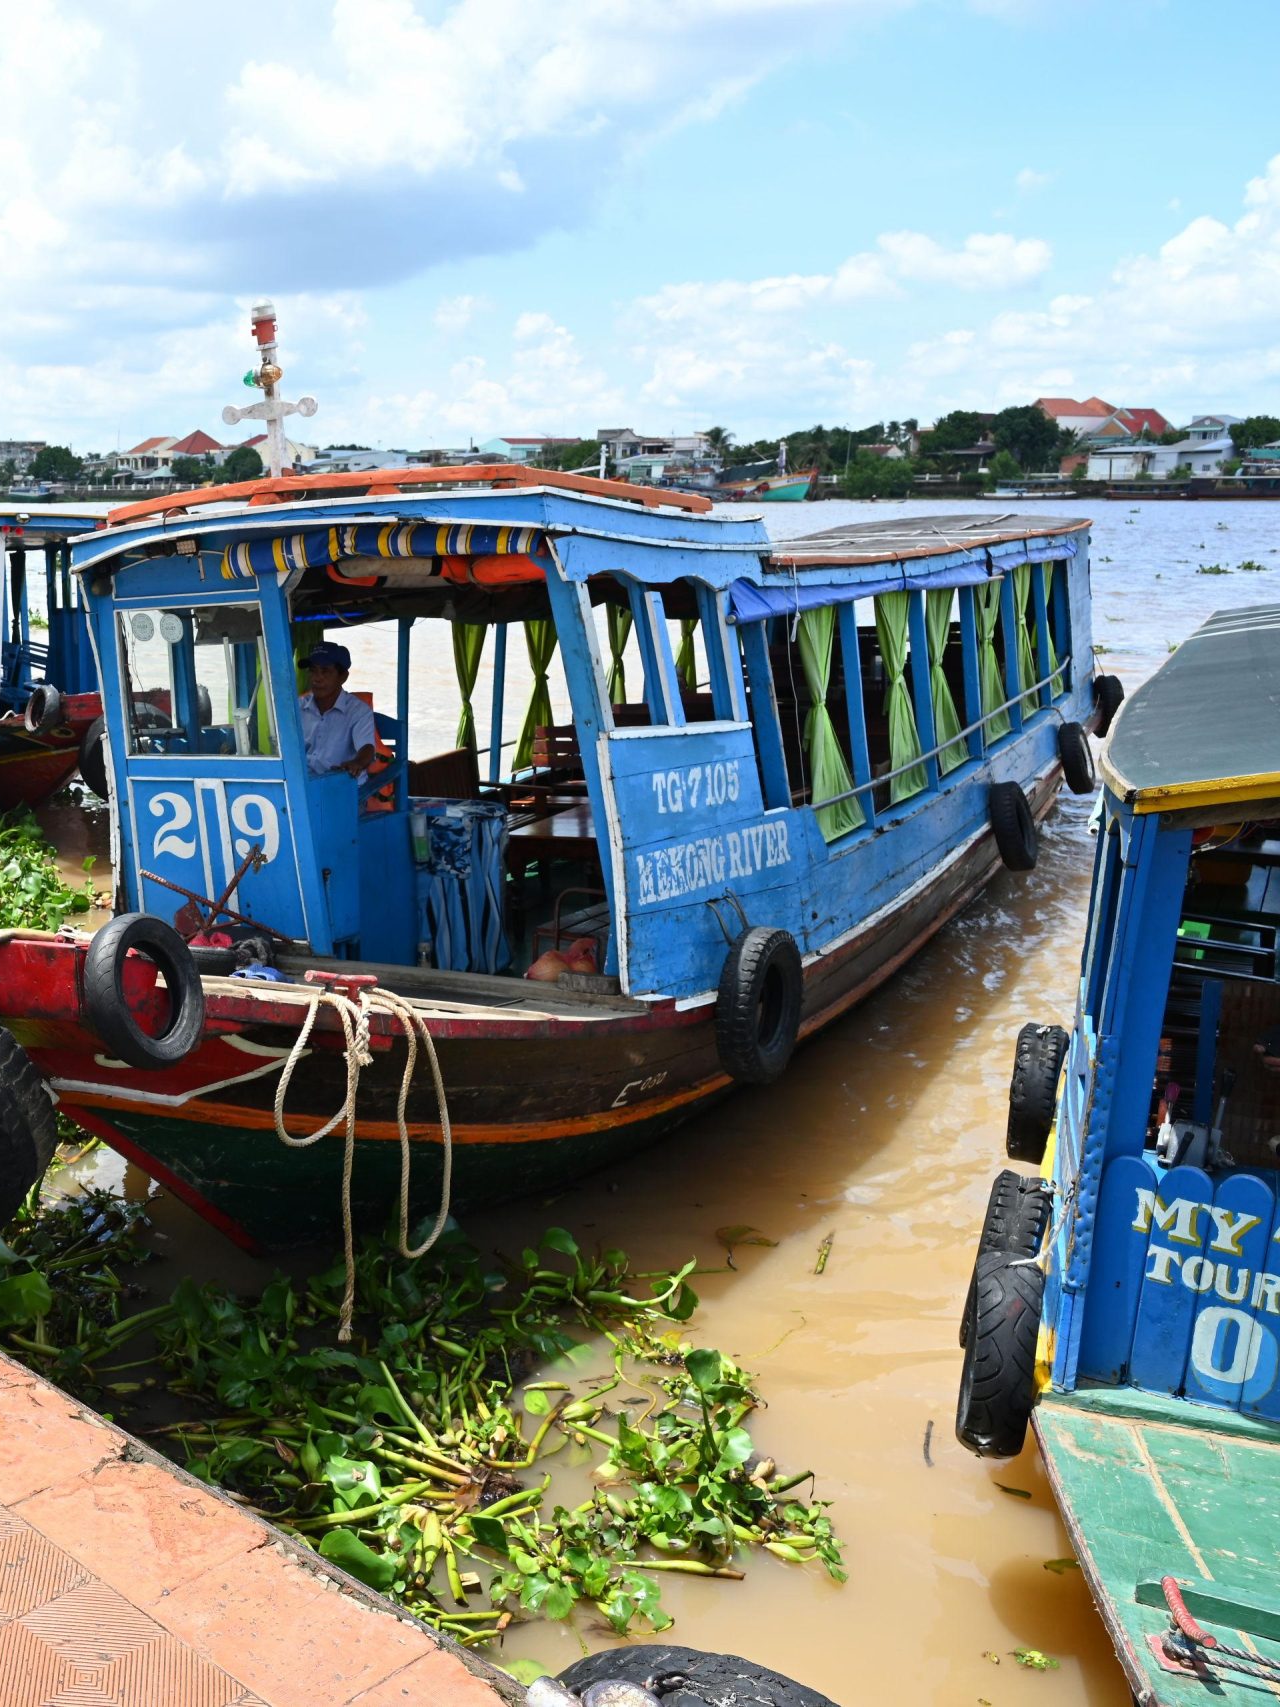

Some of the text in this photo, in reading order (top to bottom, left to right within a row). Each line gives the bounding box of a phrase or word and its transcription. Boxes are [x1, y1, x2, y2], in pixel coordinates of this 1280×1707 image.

[636, 820, 791, 906] MEKONG RIVER
[1132, 1187, 1261, 1256] MY
[1145, 1243, 1280, 1315] TOUR
